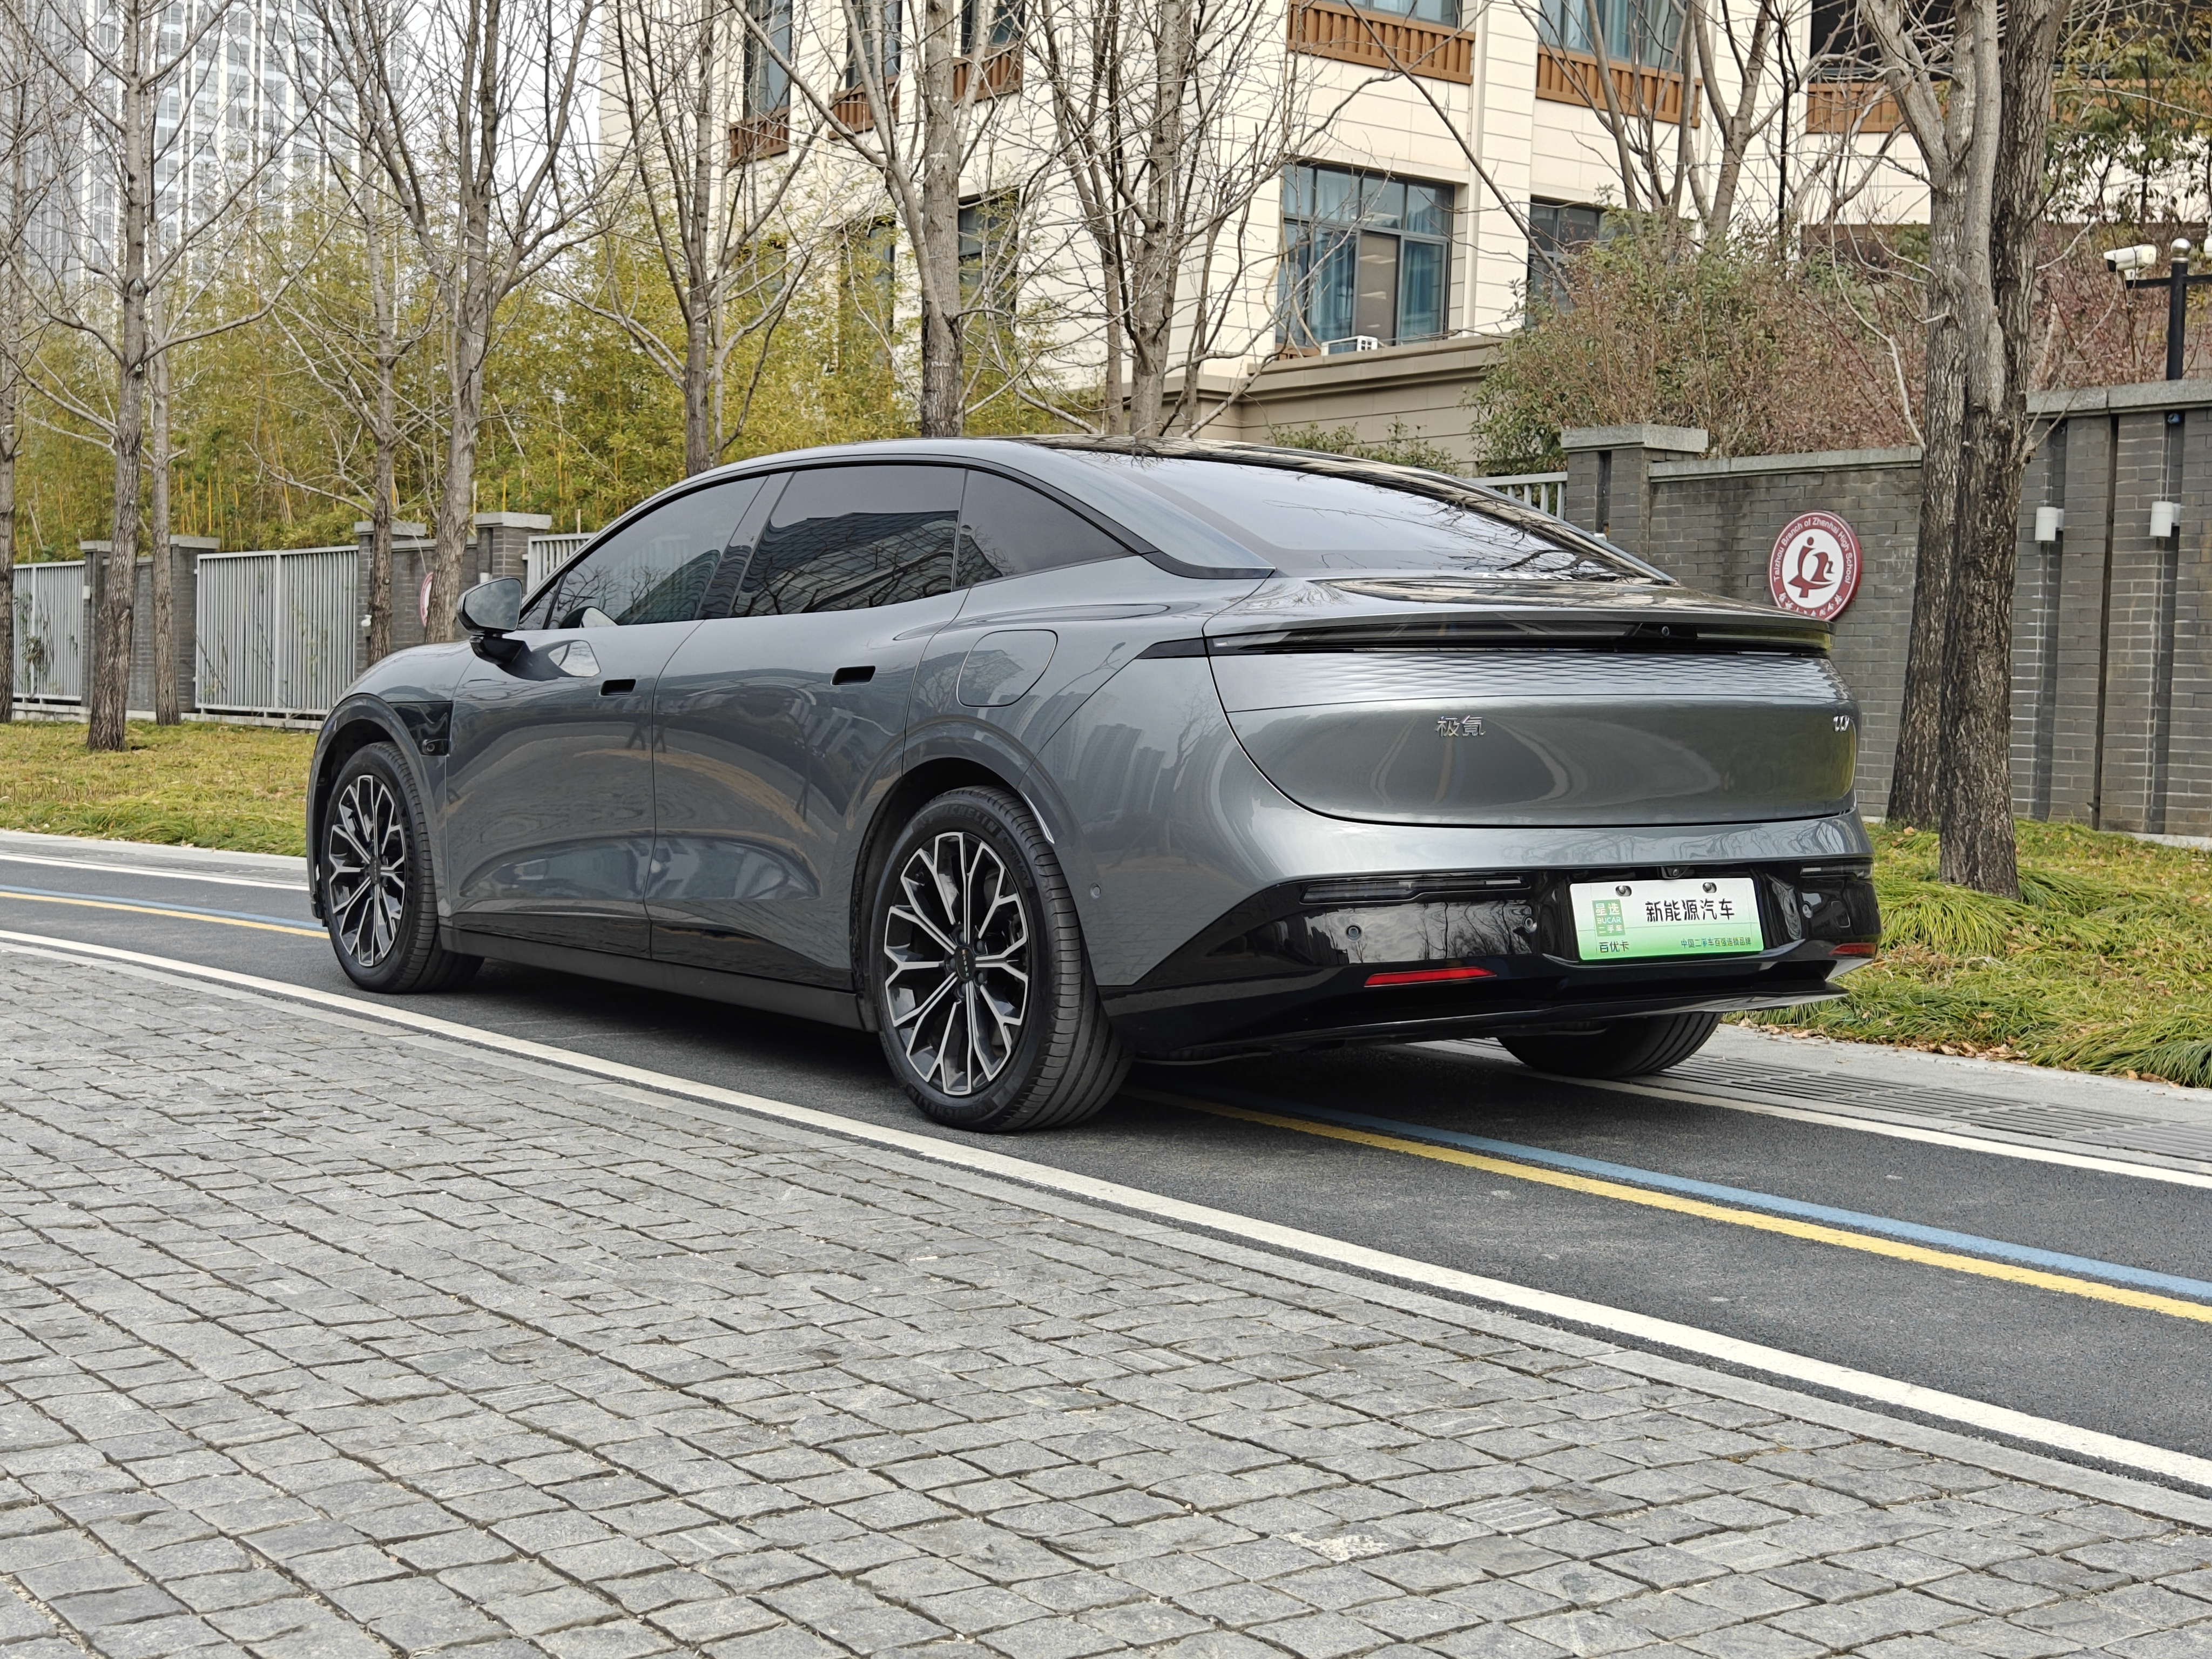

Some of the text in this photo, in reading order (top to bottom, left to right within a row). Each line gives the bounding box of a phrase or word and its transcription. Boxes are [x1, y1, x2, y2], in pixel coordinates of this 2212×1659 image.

[1773, 517, 1853, 584] Taizhou Branch of Zhenhai High School
[1435, 714, 1486, 737] 极氪
[1645, 898, 1735, 922] 新能源汽车
[1599, 940, 1630, 953] 百优卡
